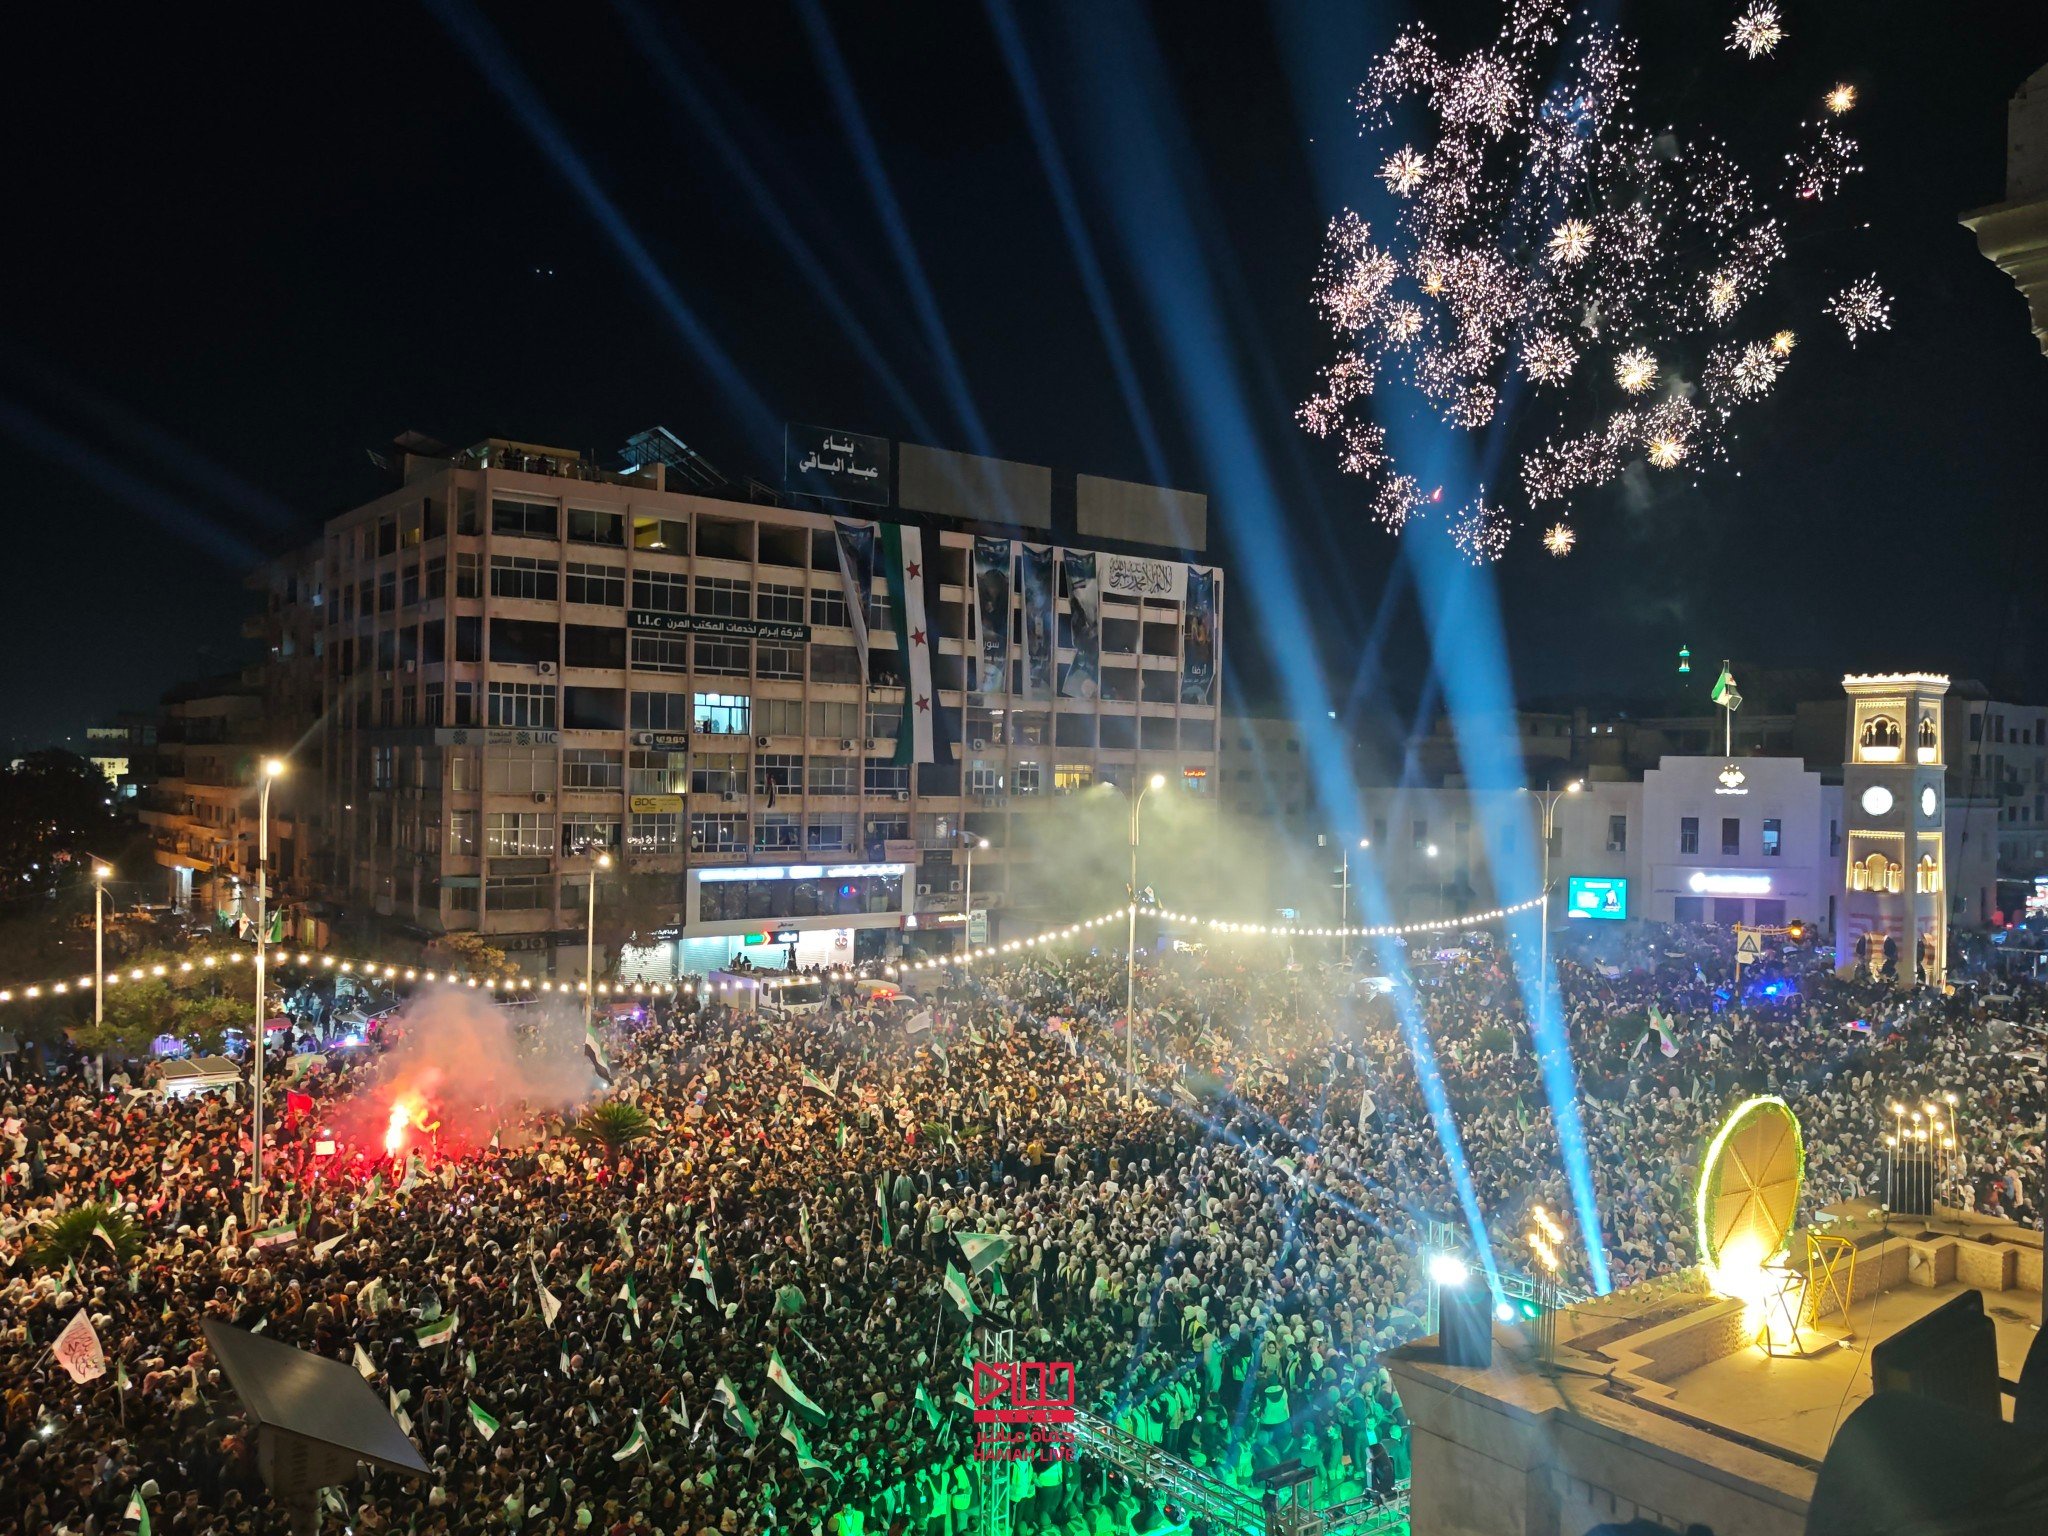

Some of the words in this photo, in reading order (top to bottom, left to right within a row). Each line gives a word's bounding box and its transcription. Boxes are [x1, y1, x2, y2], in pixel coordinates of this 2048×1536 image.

[823, 434, 854, 457] بناء
[799, 451, 844, 475] الباقي
[847, 461, 878, 480] عبد
[666, 619, 690, 631] المرن
[692, 620, 725, 631] المكتب
[726, 623, 757, 634] لخدمات
[780, 627, 804, 640] شركة
[534, 732, 558, 744] UIC
[634, 798, 657, 806] BDC
